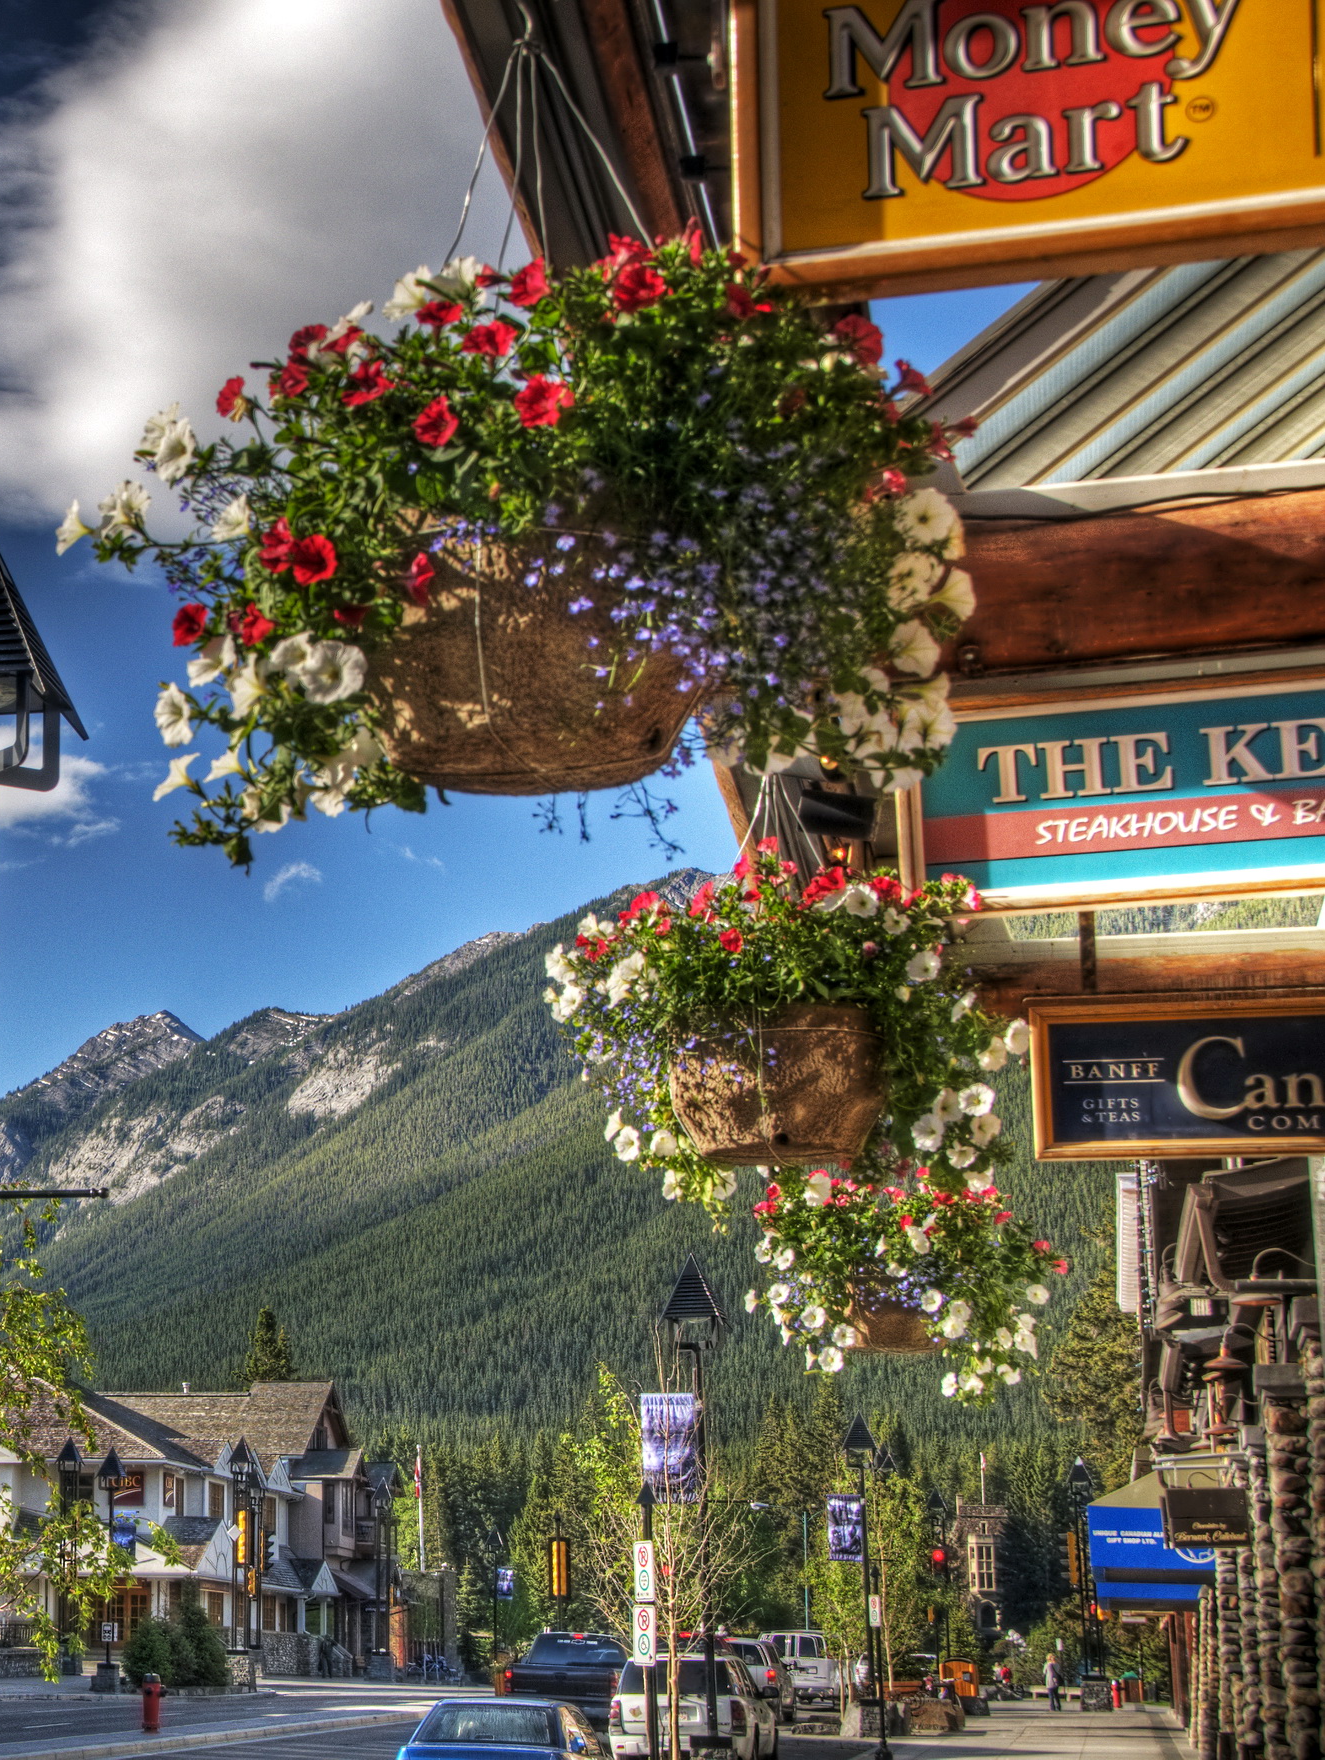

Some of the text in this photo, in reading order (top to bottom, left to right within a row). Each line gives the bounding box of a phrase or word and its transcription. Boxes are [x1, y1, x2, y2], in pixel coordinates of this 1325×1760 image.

[823, 0, 1241, 98] Money
[862, 80, 1189, 200] Mart
[977, 731, 1174, 804] THE
[1035, 804, 1239, 845] STEAKHOUSE
[1249, 802, 1282, 826] &
[1070, 1062, 1160, 1079] BANFF
[1177, 1036, 1325, 1120] Can
[1082, 1098, 1139, 1109] GIFTS
[1247, 1115, 1321, 1130] COM
[111, 1475, 141, 1487] CIBC
